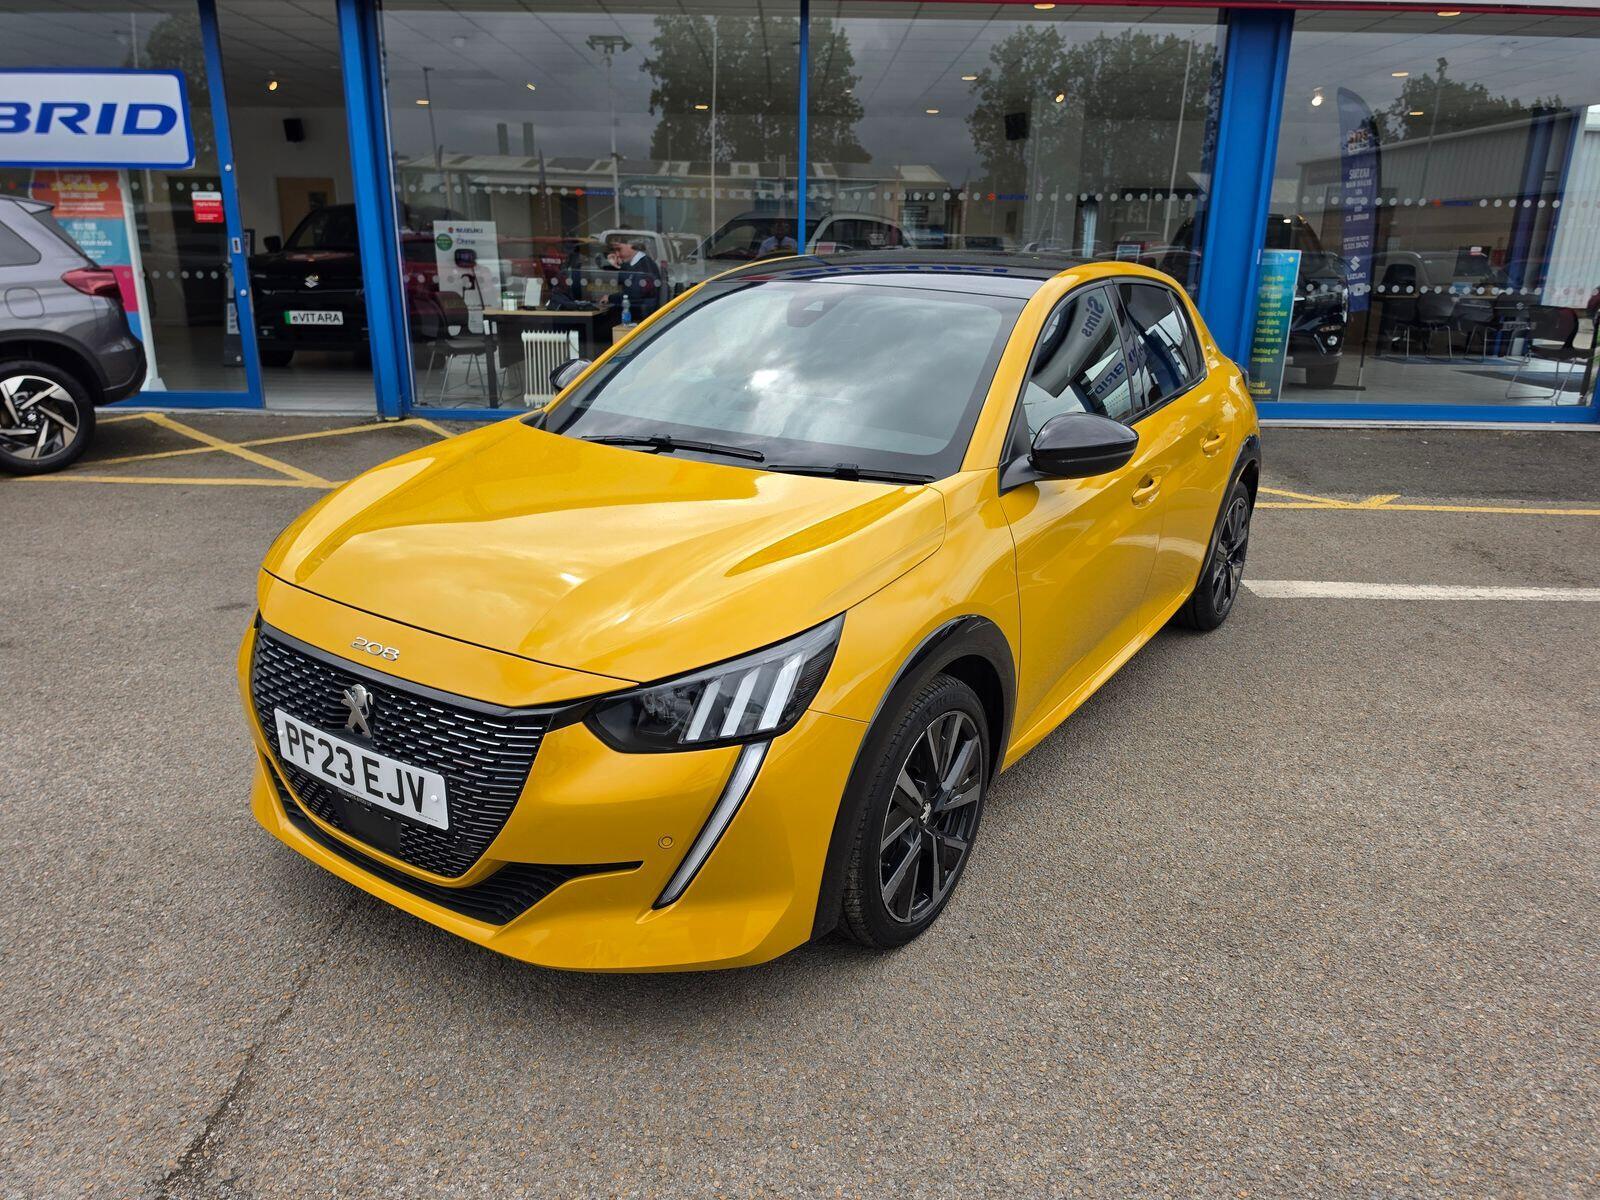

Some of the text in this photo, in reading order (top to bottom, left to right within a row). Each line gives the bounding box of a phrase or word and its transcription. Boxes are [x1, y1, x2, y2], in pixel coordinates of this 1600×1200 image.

[292, 313, 341, 323] eVITARA
[351, 636, 400, 661] 208
[285, 720, 425, 813] PF23 EJV
